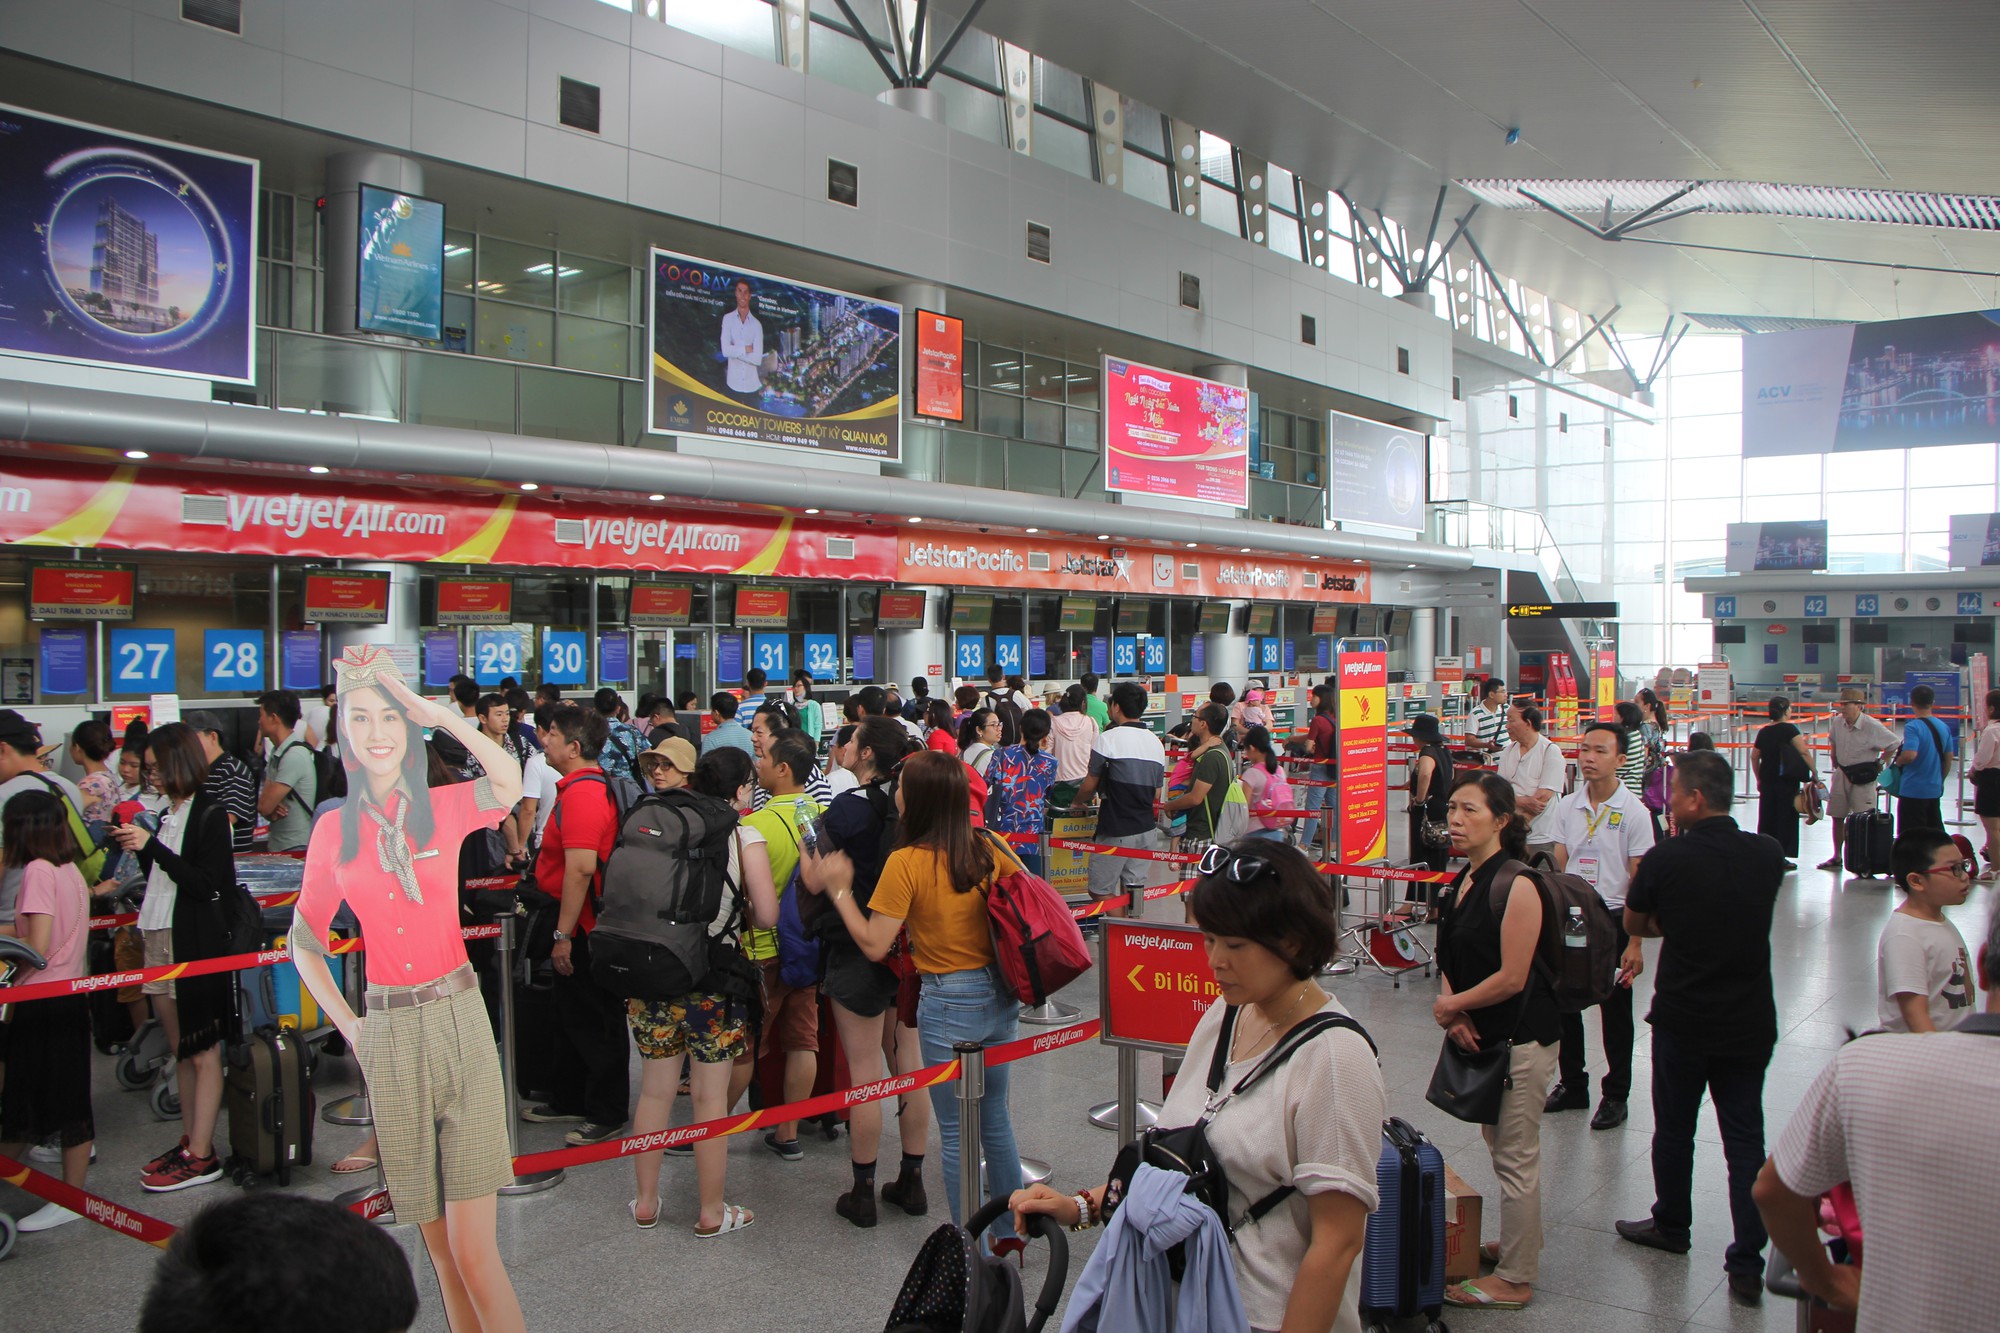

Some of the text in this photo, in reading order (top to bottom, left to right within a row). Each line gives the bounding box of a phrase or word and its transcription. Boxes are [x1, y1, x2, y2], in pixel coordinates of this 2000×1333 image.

[1757, 385, 1792, 399] ACV
[706, 410, 888, 447] COCOBAY TOWERS MỘT KỲ QUAN MỚI
[706, 426, 717, 434] HN:
[718, 427, 733, 436] 0948
[766, 433, 781, 442] HCM:
[845, 444, 888, 456] www.cocobay.vn
[1064, 553, 1117, 577] Jetstar
[1321, 573, 1355, 592] Jetstar
[1717, 600, 1732, 614] 41
[1806, 600, 1824, 613] 42
[1857, 598, 1876, 612] 43
[1960, 597, 1979, 611] 44
[119, 642, 169, 680] 27
[212, 641, 258, 678] 28
[482, 642, 515, 674] 29
[548, 642, 582, 673] 30
[760, 643, 783, 670] 31
[808, 643, 833, 670] 32
[961, 643, 981, 668] 33
[999, 643, 1019, 667] 34
[1117, 644, 1134, 666] 35
[1147, 644, 1163, 665] 36
[1264, 644, 1277, 663] 38
[1063, 823, 1080, 833] BẢO
[1155, 972, 1223, 996] Đi lối nà
